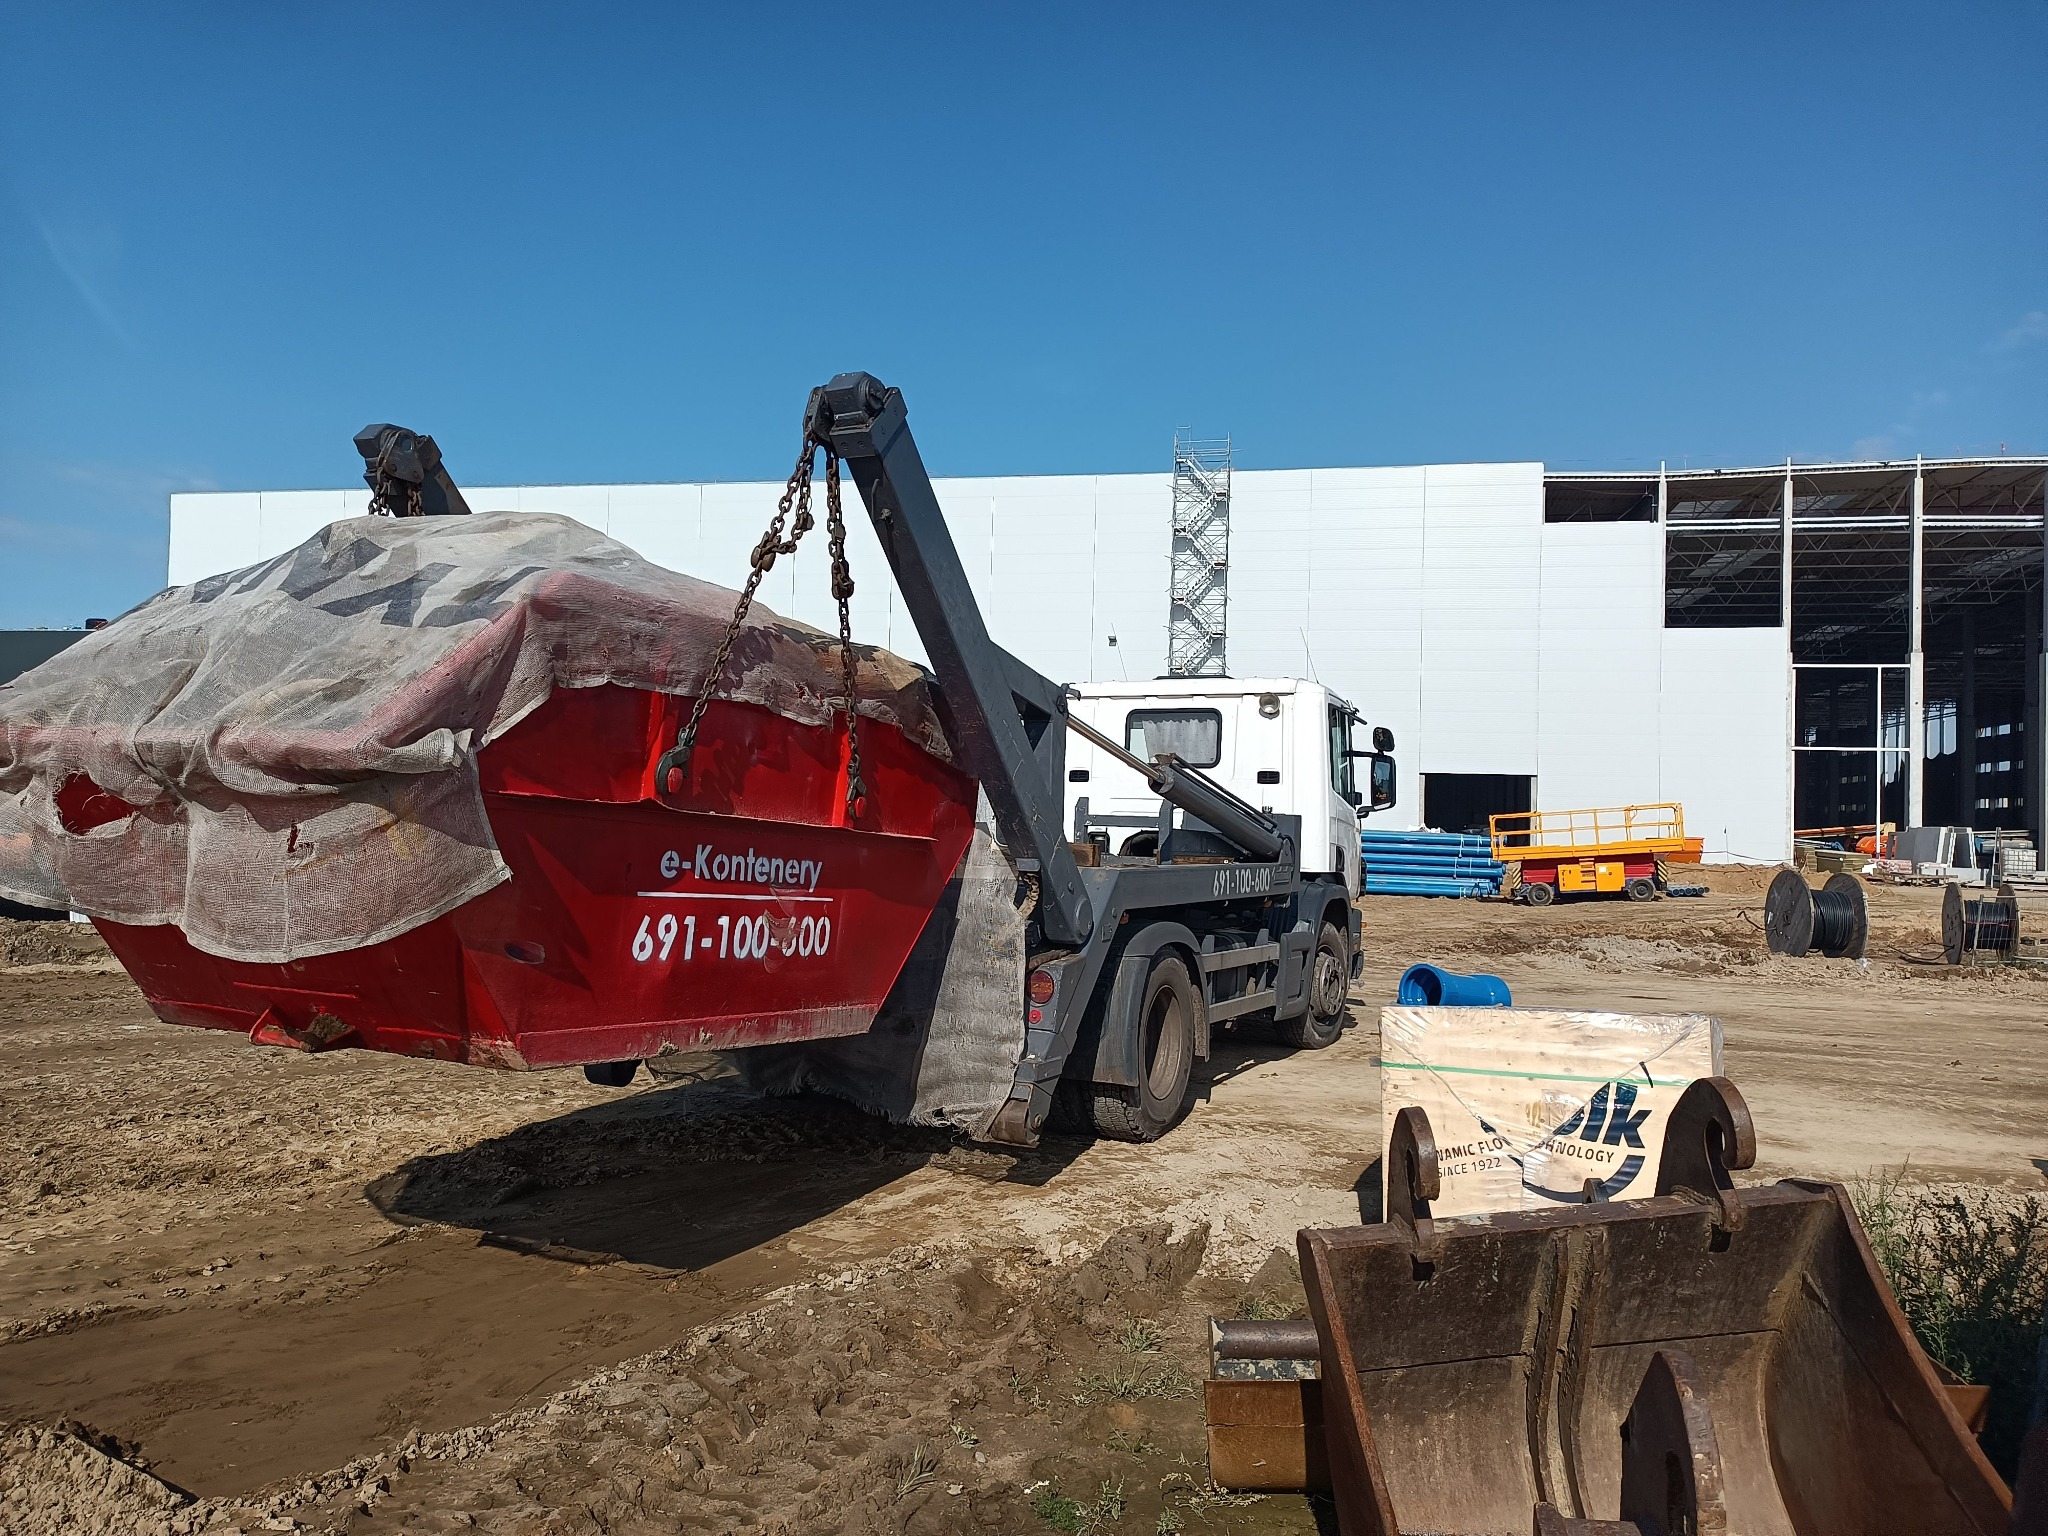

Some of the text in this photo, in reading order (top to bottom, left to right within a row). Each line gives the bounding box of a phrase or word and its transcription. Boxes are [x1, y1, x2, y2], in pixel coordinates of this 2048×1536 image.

[660, 844, 823, 892] e-Kontenery
[1213, 867, 1270, 897] 691-100-600
[1436, 1144, 1476, 1162] NAMIC
[1478, 1137, 1504, 1154] FLO
[1438, 1157, 1502, 1178] SINCE 1922
